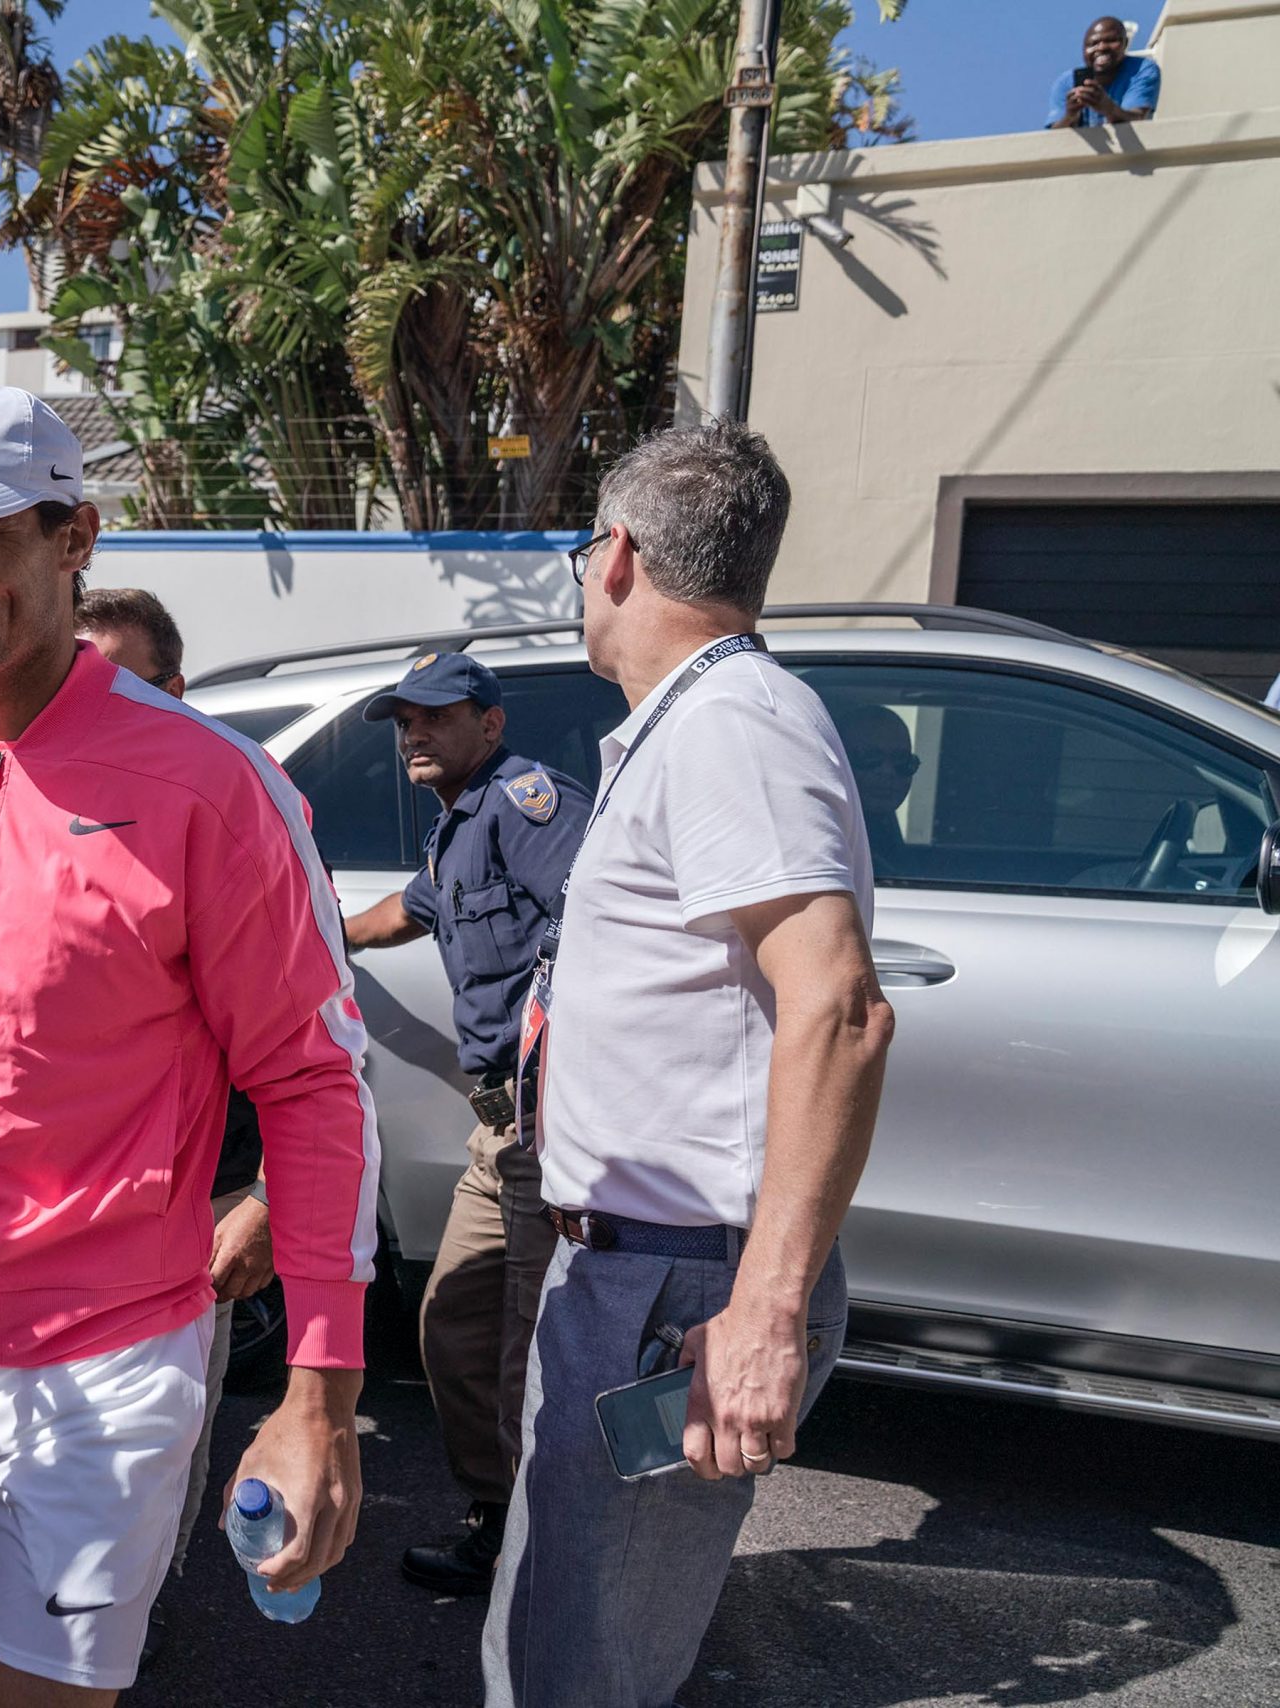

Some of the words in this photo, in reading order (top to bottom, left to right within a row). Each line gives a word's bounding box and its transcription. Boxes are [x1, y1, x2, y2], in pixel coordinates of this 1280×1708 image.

[740, 635, 751, 643] IN
[707, 637, 740, 655] AFRICA
[741, 642, 756, 650] THE
[709, 644, 743, 662] MATCH
